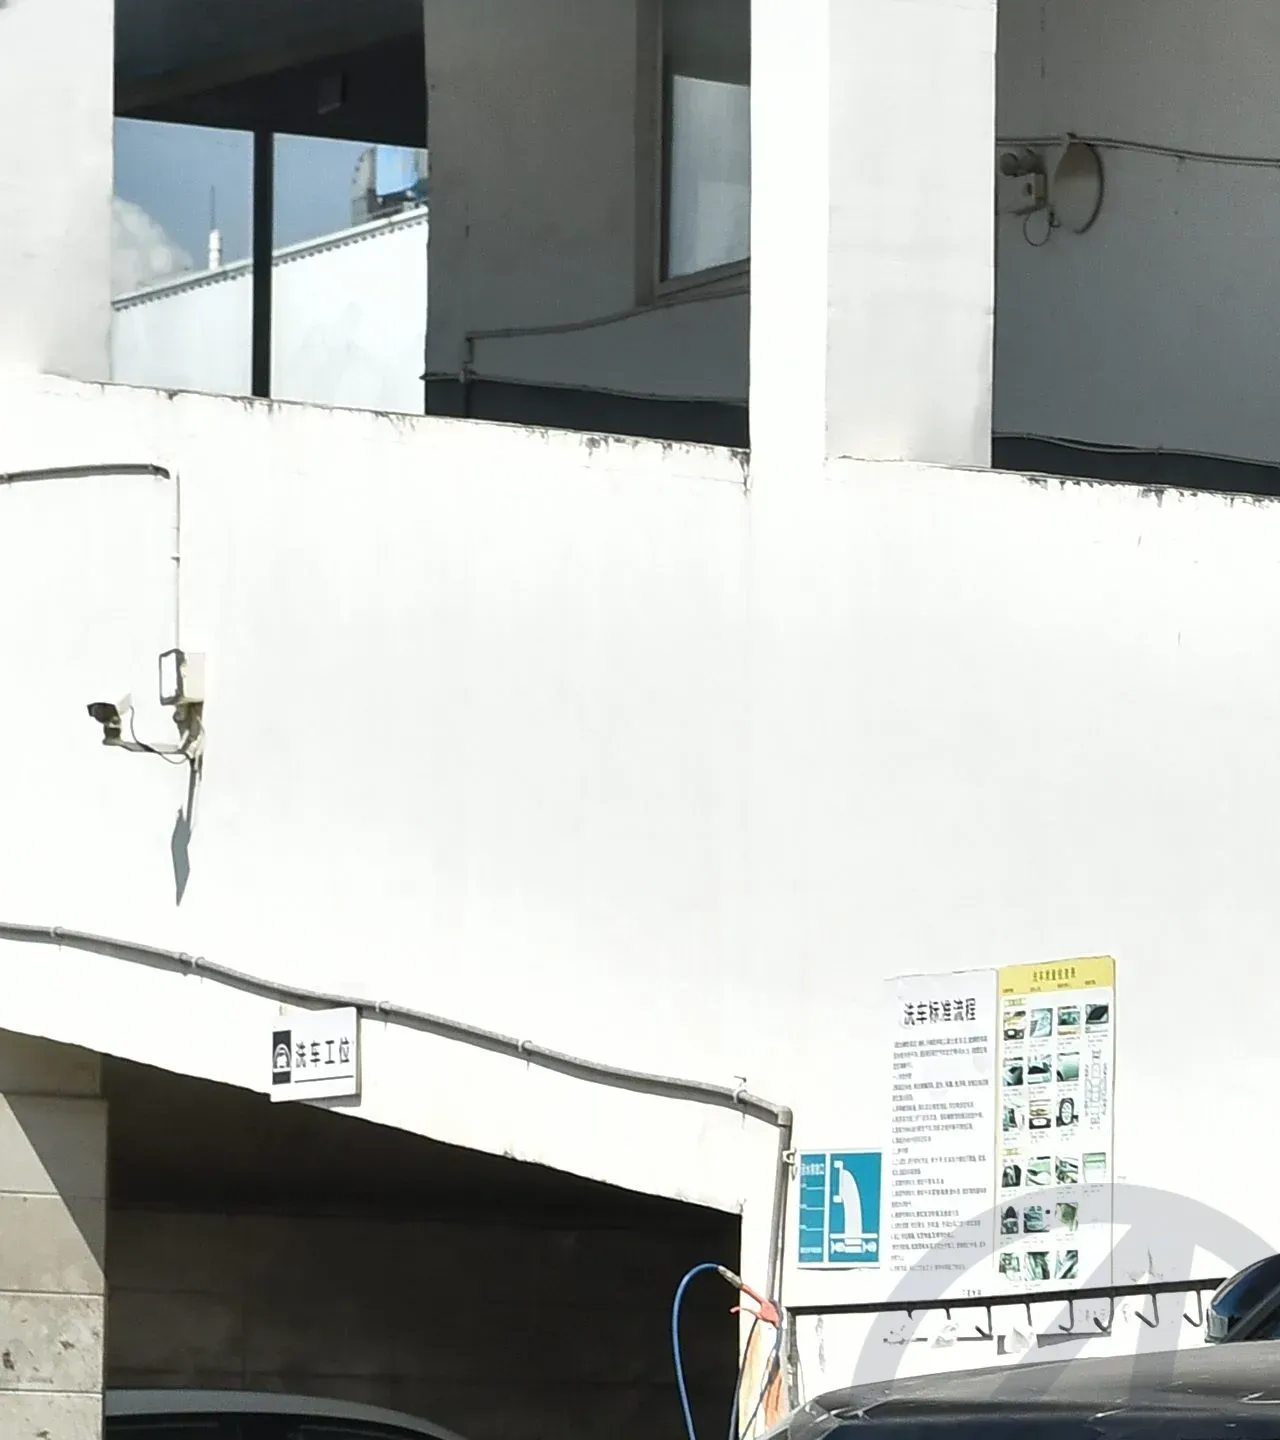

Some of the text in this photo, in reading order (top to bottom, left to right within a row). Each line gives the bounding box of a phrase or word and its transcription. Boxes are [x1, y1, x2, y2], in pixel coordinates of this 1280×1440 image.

[903, 997, 977, 1026] 洗车标准流程
[294, 1036, 351, 1069] 洗车工位
